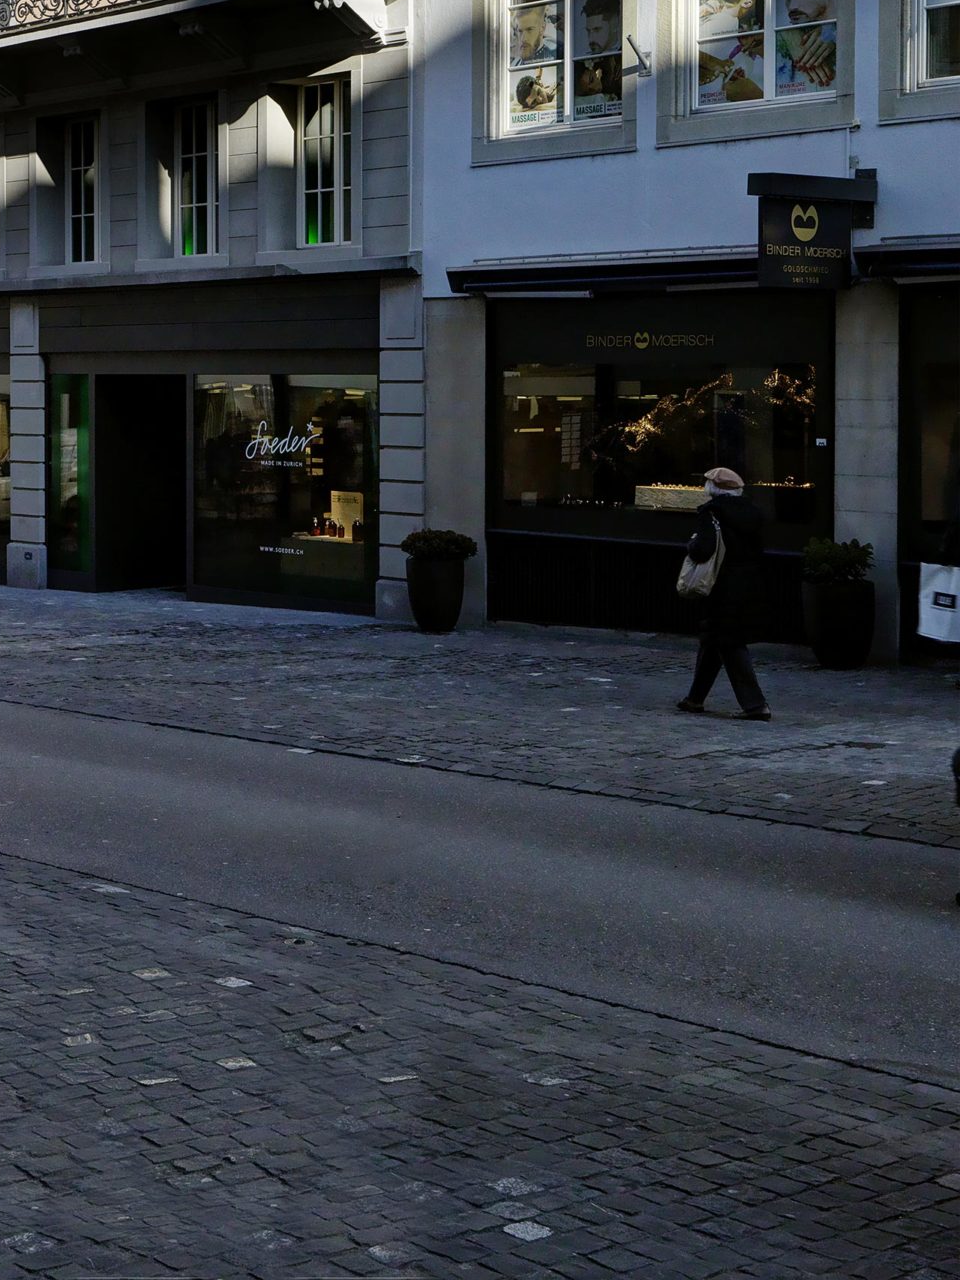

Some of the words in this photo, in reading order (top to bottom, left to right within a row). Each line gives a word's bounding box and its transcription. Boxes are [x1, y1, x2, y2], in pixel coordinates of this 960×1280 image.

[576, 102, 604, 116] MASSAGE
[511, 113, 537, 123] MASSAGE
[766, 243, 801, 257] BINDER
[804, 246, 849, 259] MOERISCH
[783, 264, 830, 274] GOLDSCHMIED
[586, 335, 632, 347] BINDER
[651, 334, 715, 347] MOERISCH
[259, 546, 304, 556] WWW.SOEDER.CH
